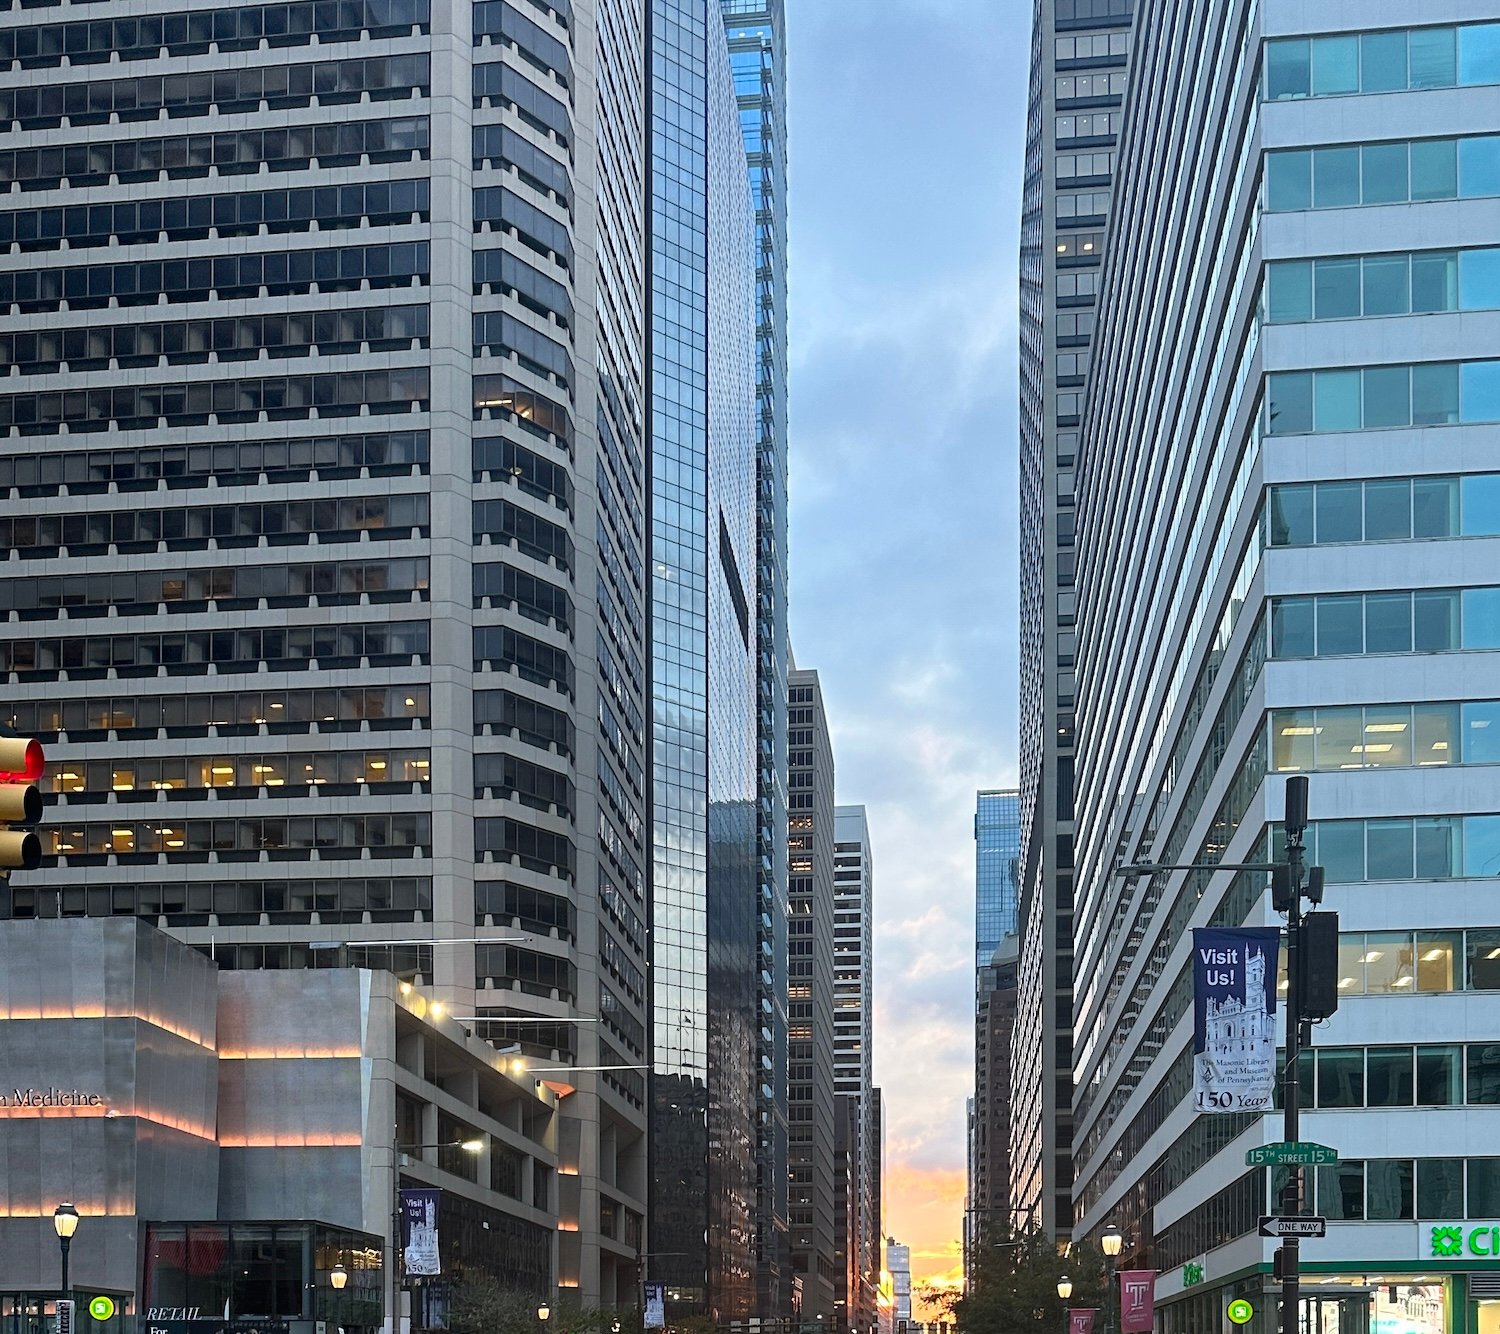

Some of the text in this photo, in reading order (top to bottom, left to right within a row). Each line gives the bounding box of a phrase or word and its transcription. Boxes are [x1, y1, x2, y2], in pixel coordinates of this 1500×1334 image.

[1200, 948, 1238, 965] Visit
[1206, 969, 1235, 986] Us!
[13, 1087, 101, 1106] Medicine
[1197, 1091, 1233, 1108] 150
[1250, 1150, 1336, 1163] 15TH STREET 15TH
[406, 1199, 423, 1207] Visit
[409, 1209, 422, 1217] Us!
[1278, 1223, 1318, 1231] ONE WAY
[1469, 1227, 1500, 1256] Ci
[407, 1265, 423, 1273] 150
[146, 1307, 203, 1320] RETAIL
